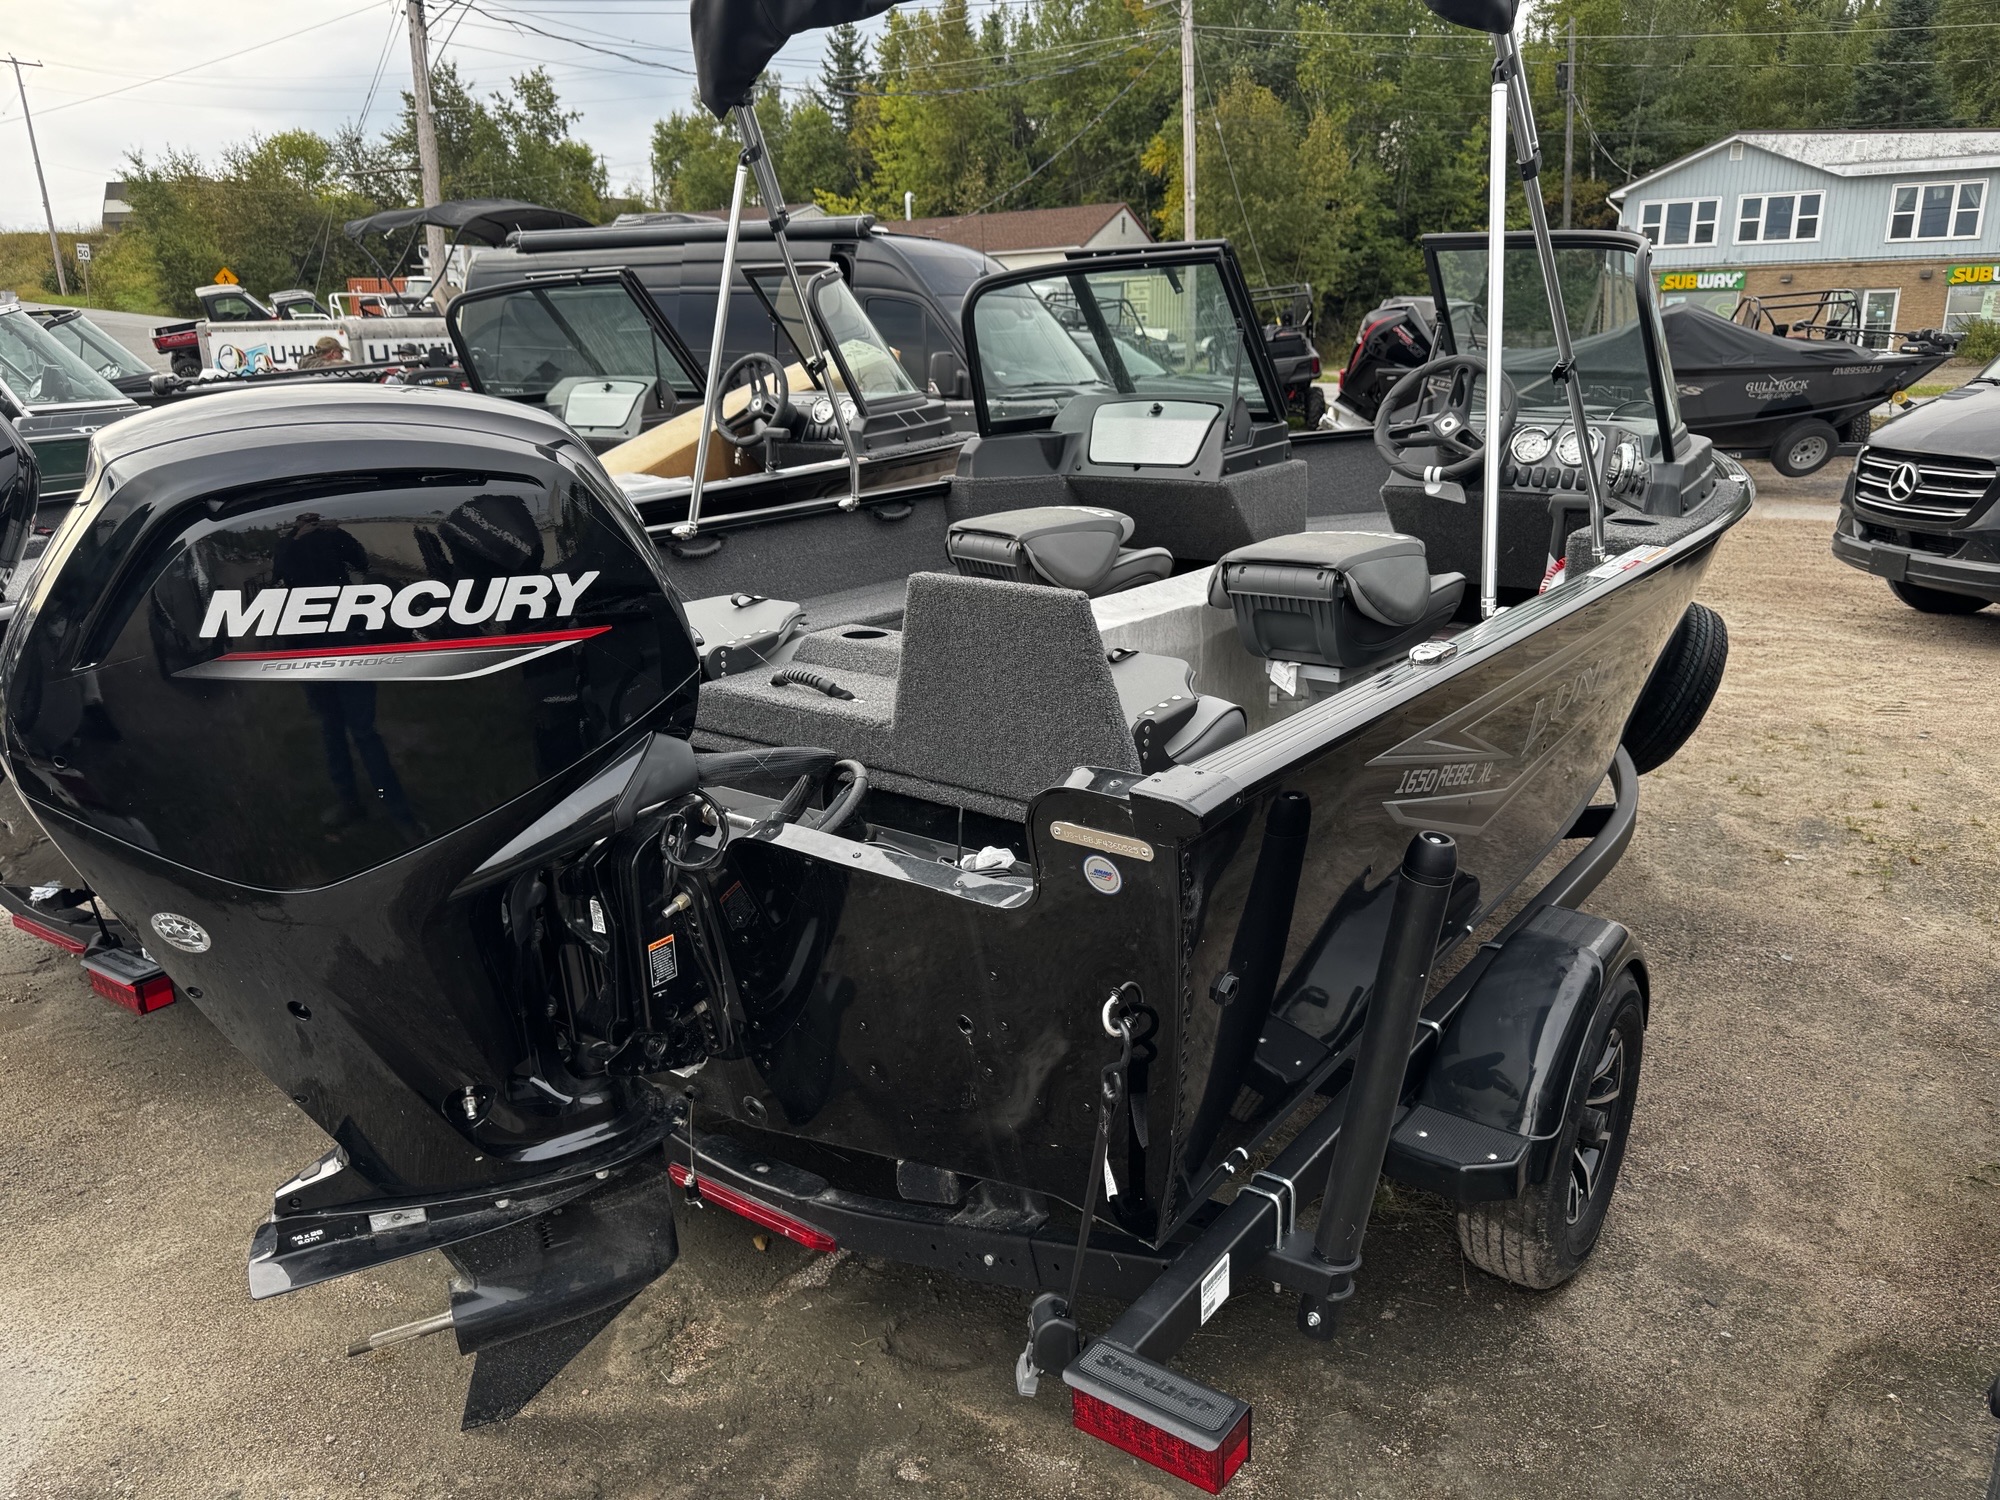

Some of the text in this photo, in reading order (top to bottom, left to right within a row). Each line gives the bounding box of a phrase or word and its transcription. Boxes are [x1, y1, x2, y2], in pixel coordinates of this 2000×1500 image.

[78, 250, 89, 258] 50
[1661, 271, 1743, 291] SUBWAY
[1746, 380, 1810, 392] GULL ROCK
[200, 571, 600, 638] MERCURY
[261, 655, 405, 671] FOURSTROKE
[1394, 769, 1439, 794] 1650
[1440, 763, 1478, 787] REBEL
